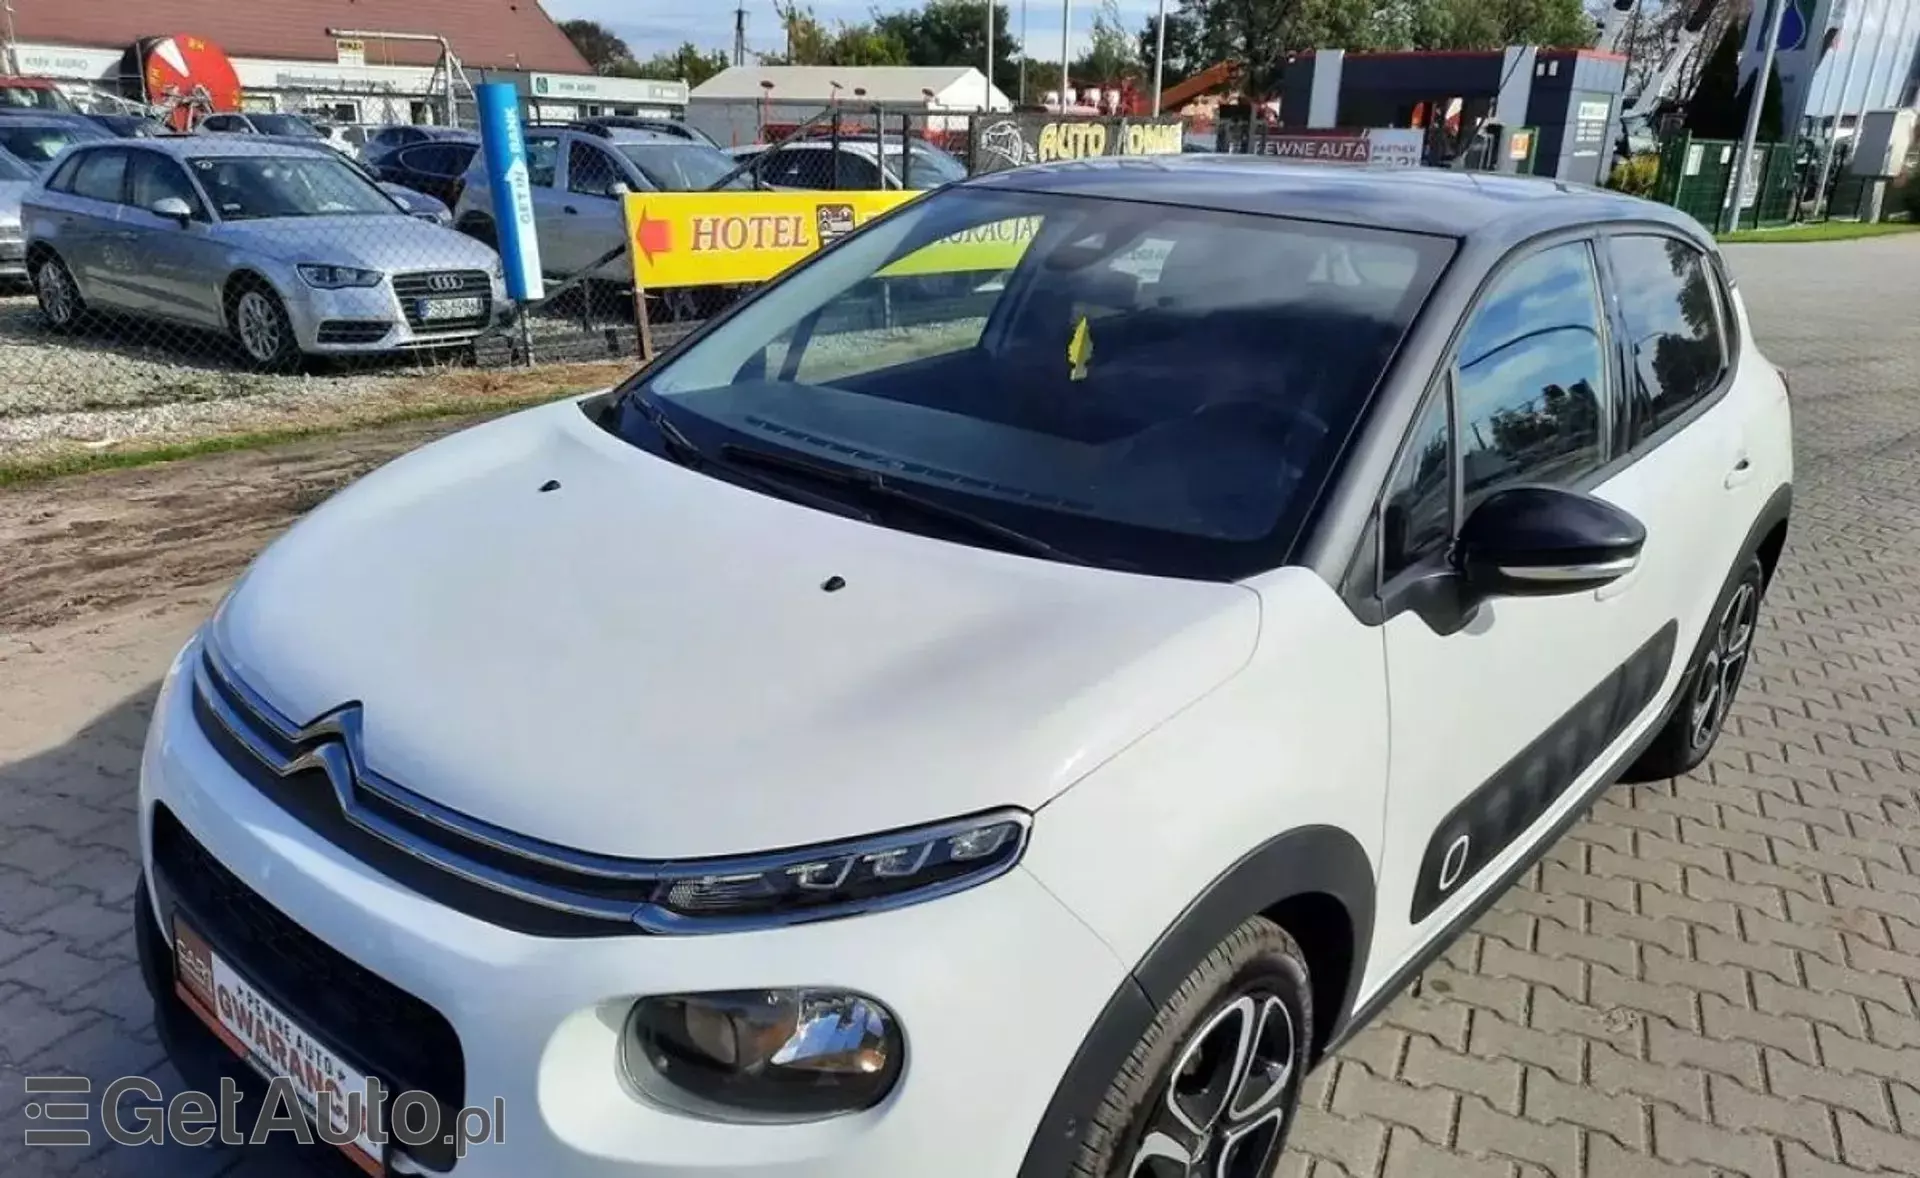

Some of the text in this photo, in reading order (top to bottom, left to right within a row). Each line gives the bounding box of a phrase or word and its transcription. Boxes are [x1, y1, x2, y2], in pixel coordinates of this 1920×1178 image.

[505, 106, 521, 154] BANK
[1038, 122, 1106, 162] AUTO
[1318, 142, 1367, 158] AUTA
[518, 194, 531, 225] GET
[690, 215, 809, 251] HOTEL
[247, 990, 334, 1077] PEWNE AUTO
